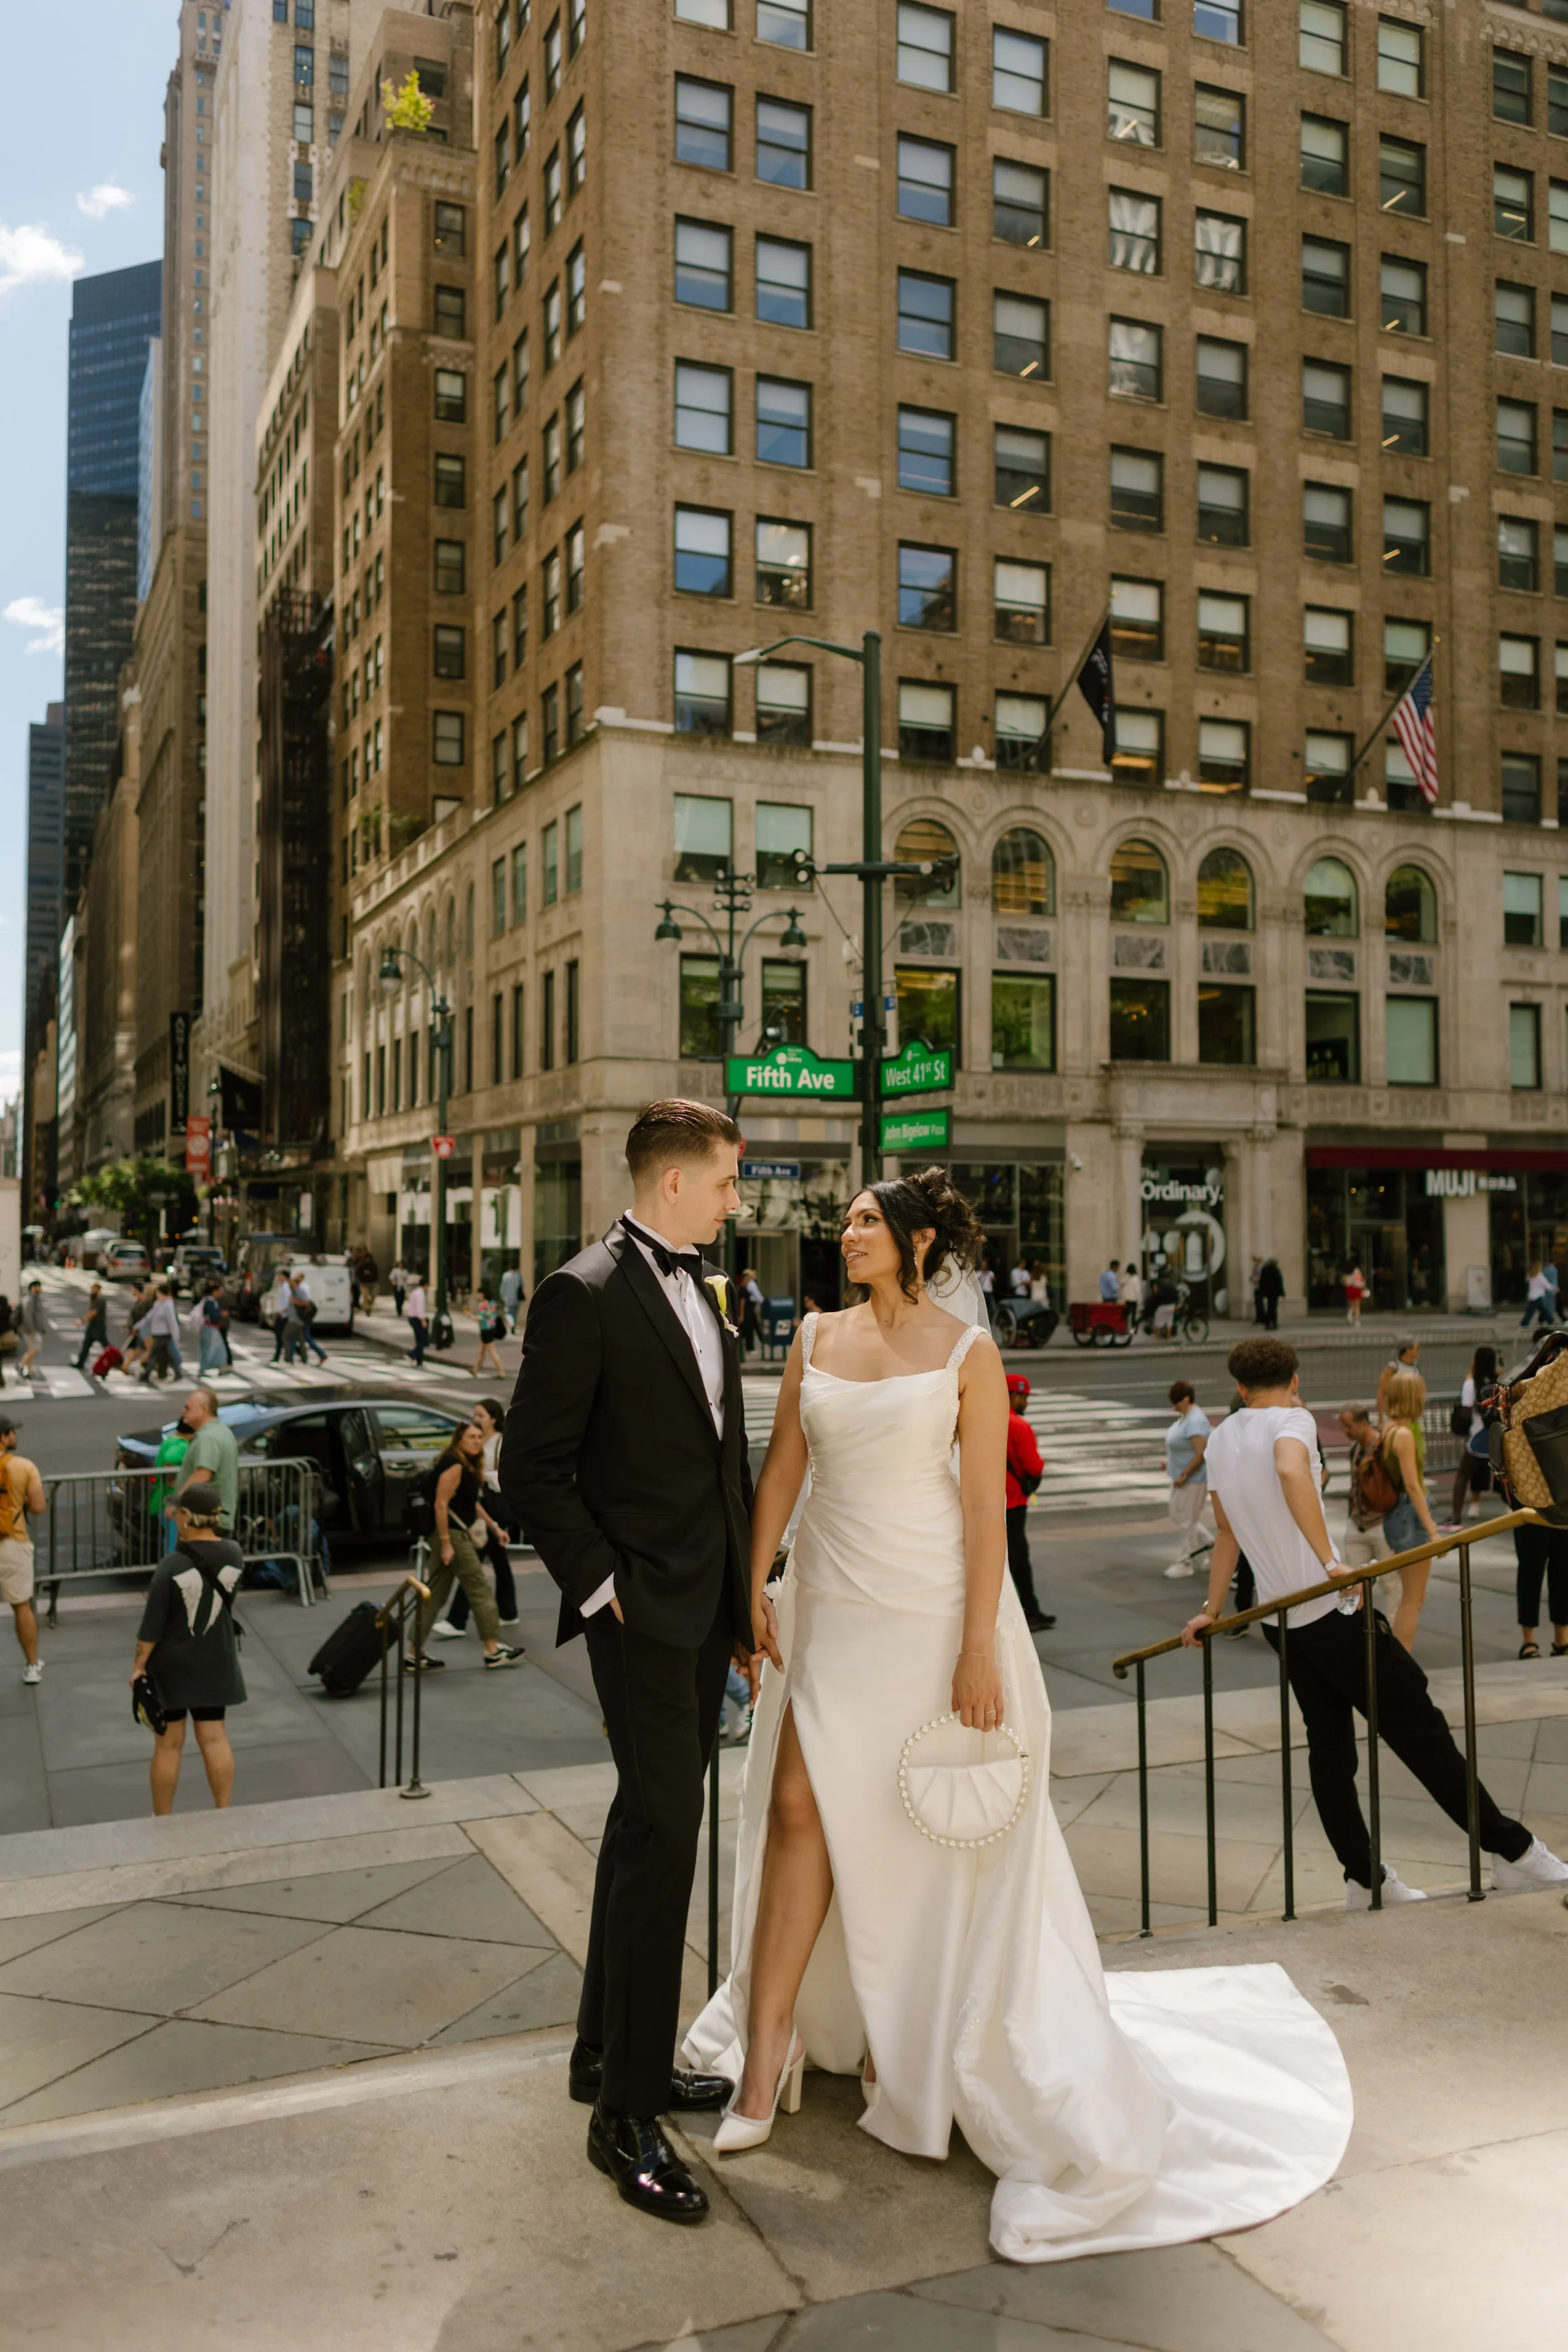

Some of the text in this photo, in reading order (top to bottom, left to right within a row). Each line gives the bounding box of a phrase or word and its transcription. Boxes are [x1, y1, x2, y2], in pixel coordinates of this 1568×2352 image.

[746, 1066, 835, 1089] Fifth Ave
[886, 1060, 945, 1087] West 41st St
[884, 1124, 901, 1140] John
[902, 1121, 930, 1142] Bigelow
[751, 1165, 792, 1175] Fifth Ave
[1426, 1168, 1475, 1197] MUJI
[1141, 1180, 1224, 1207] Ordinary.
